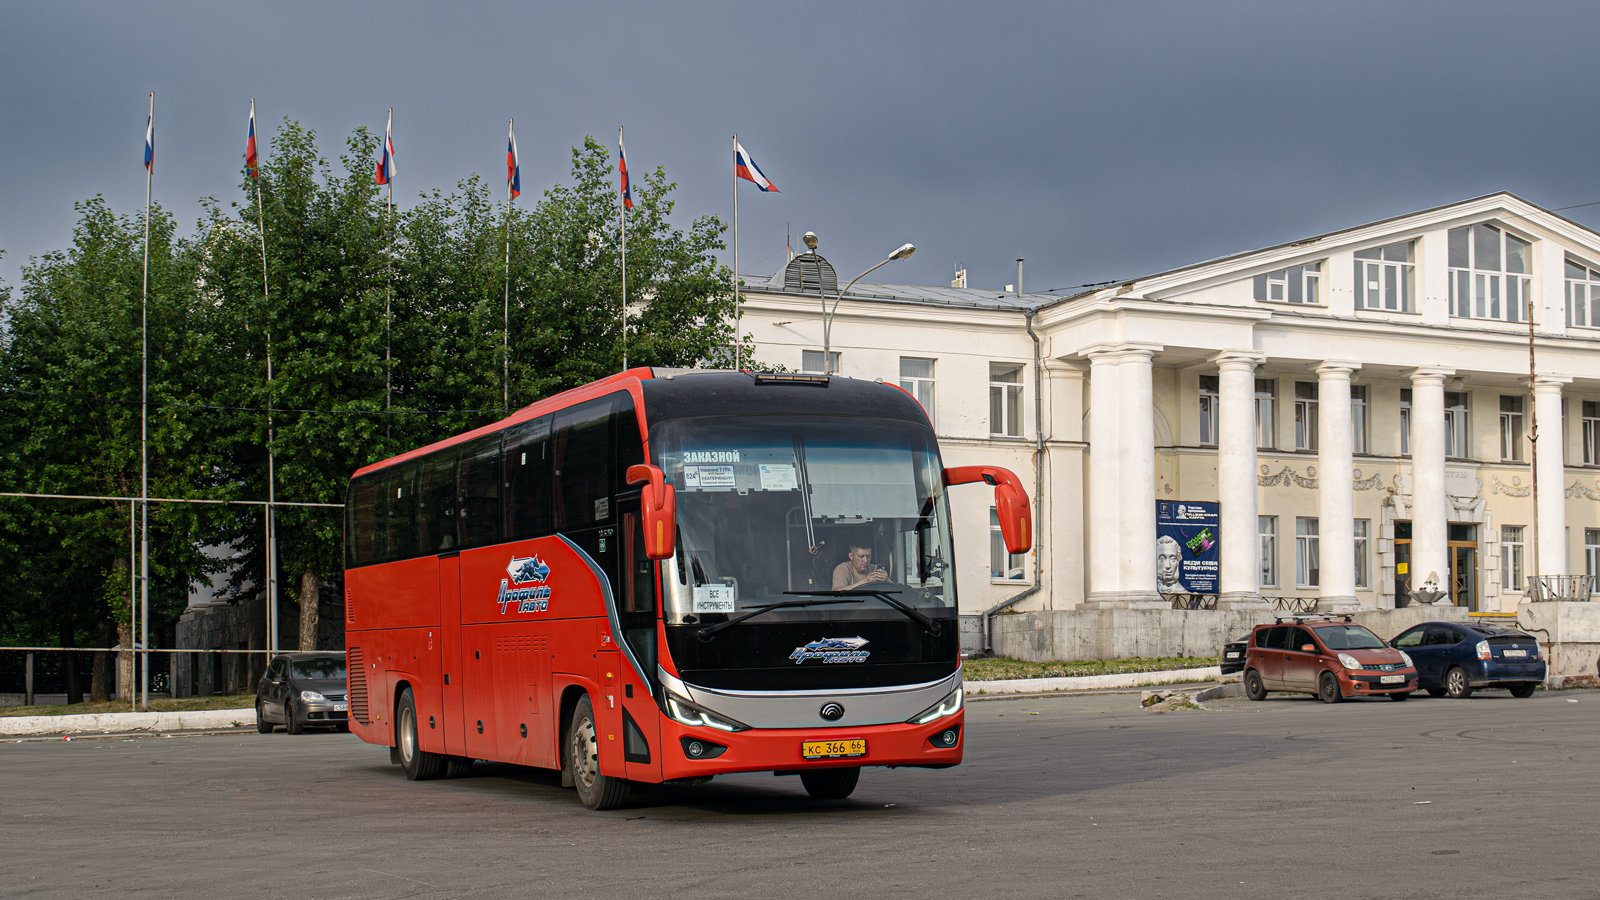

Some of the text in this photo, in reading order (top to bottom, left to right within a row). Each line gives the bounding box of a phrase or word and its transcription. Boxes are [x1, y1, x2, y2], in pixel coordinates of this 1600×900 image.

[683, 450, 740, 463] ЗАКАЗНОЙ
[497, 578, 551, 614] Профиль
[709, 590, 729, 598] ВСЕ 1
[696, 601, 733, 610] ИНСТРУМЕНТЫ
[789, 647, 871, 664] Профиль
[808, 741, 862, 754] КС 366 66
